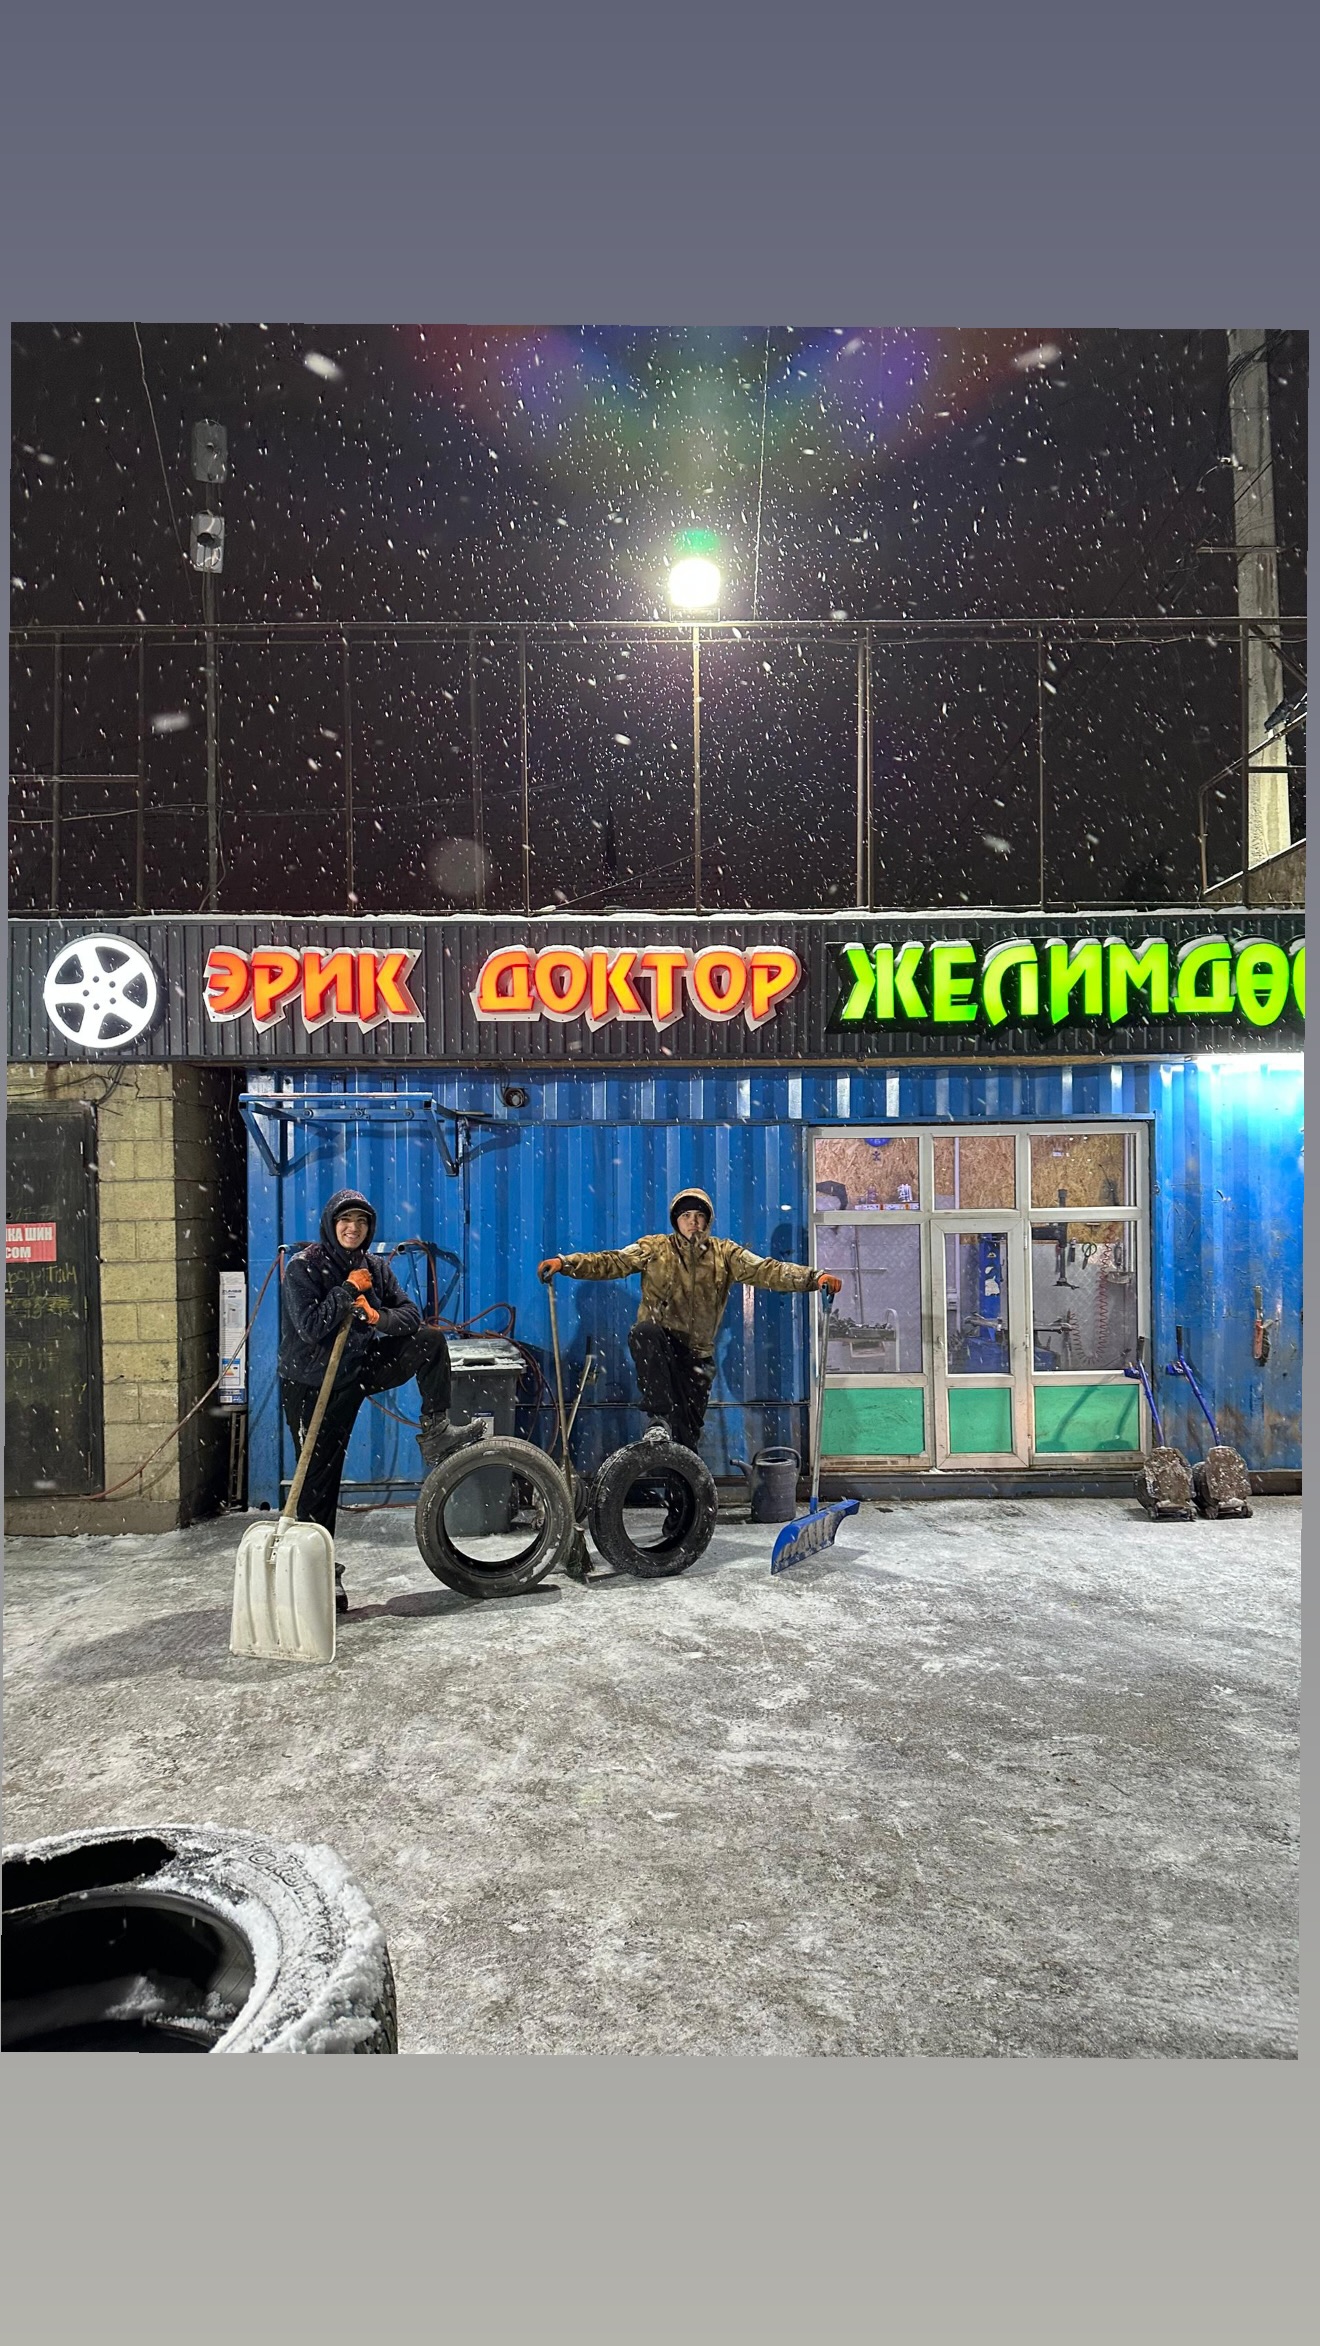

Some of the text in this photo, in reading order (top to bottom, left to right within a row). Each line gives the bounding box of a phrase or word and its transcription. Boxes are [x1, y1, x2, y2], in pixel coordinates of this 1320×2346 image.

[205, 949, 799, 1022] ЭРИК ДОКТОР
[841, 940, 1305, 1027] ЖЕЛИМДӨ
[6, 1226, 53, 1242] КА ШИН
